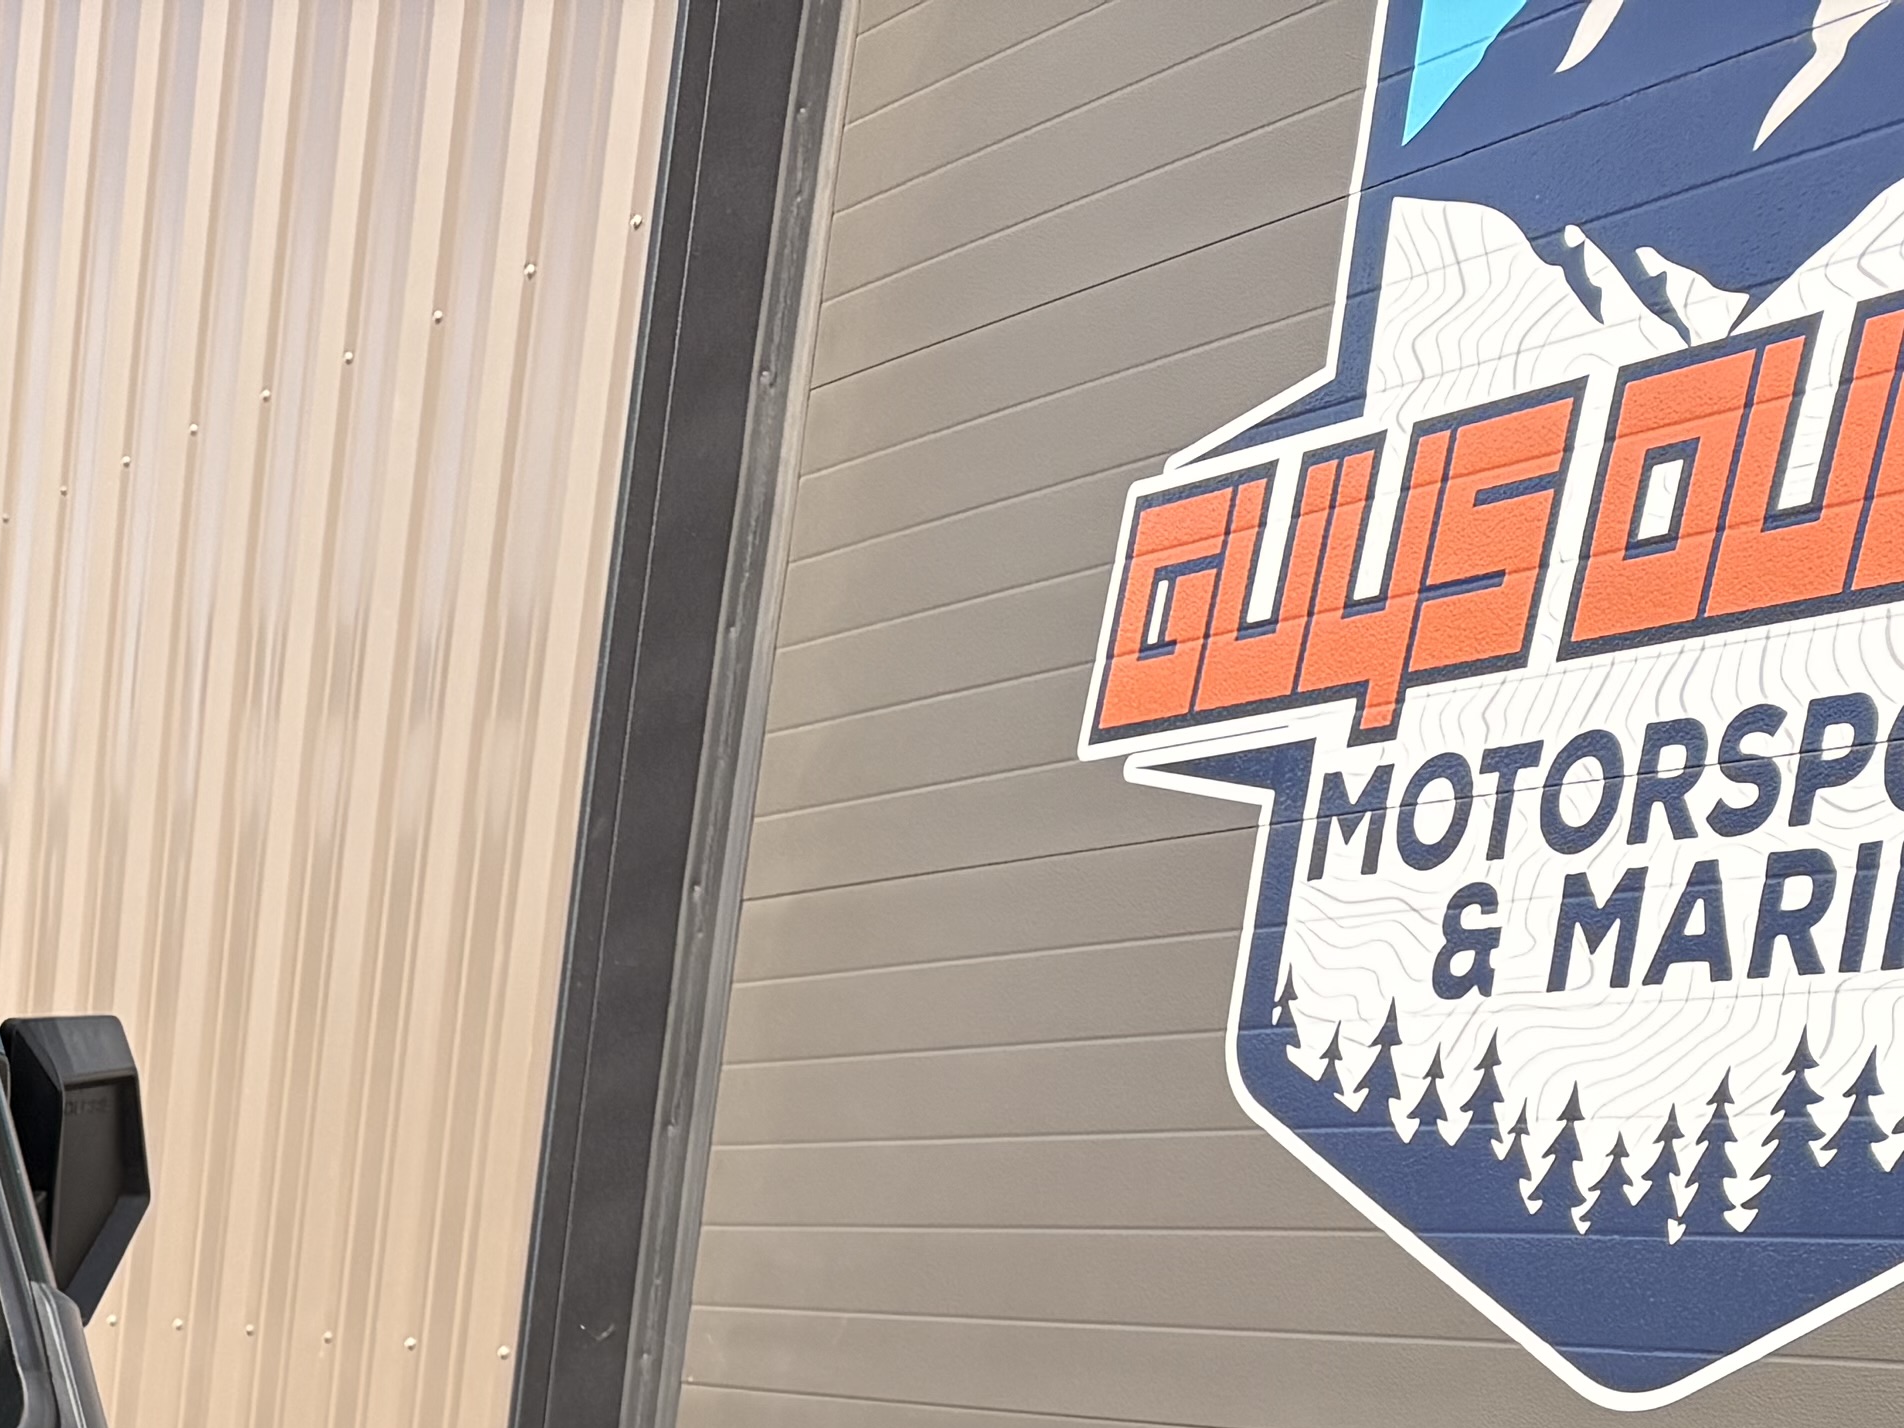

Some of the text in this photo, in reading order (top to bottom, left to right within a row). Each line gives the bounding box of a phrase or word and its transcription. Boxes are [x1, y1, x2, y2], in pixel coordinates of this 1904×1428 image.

[1092, 384, 1586, 745] GUYS
[1306, 691, 1904, 882] MOTORSP
[1431, 837, 1904, 1001] & MARI
